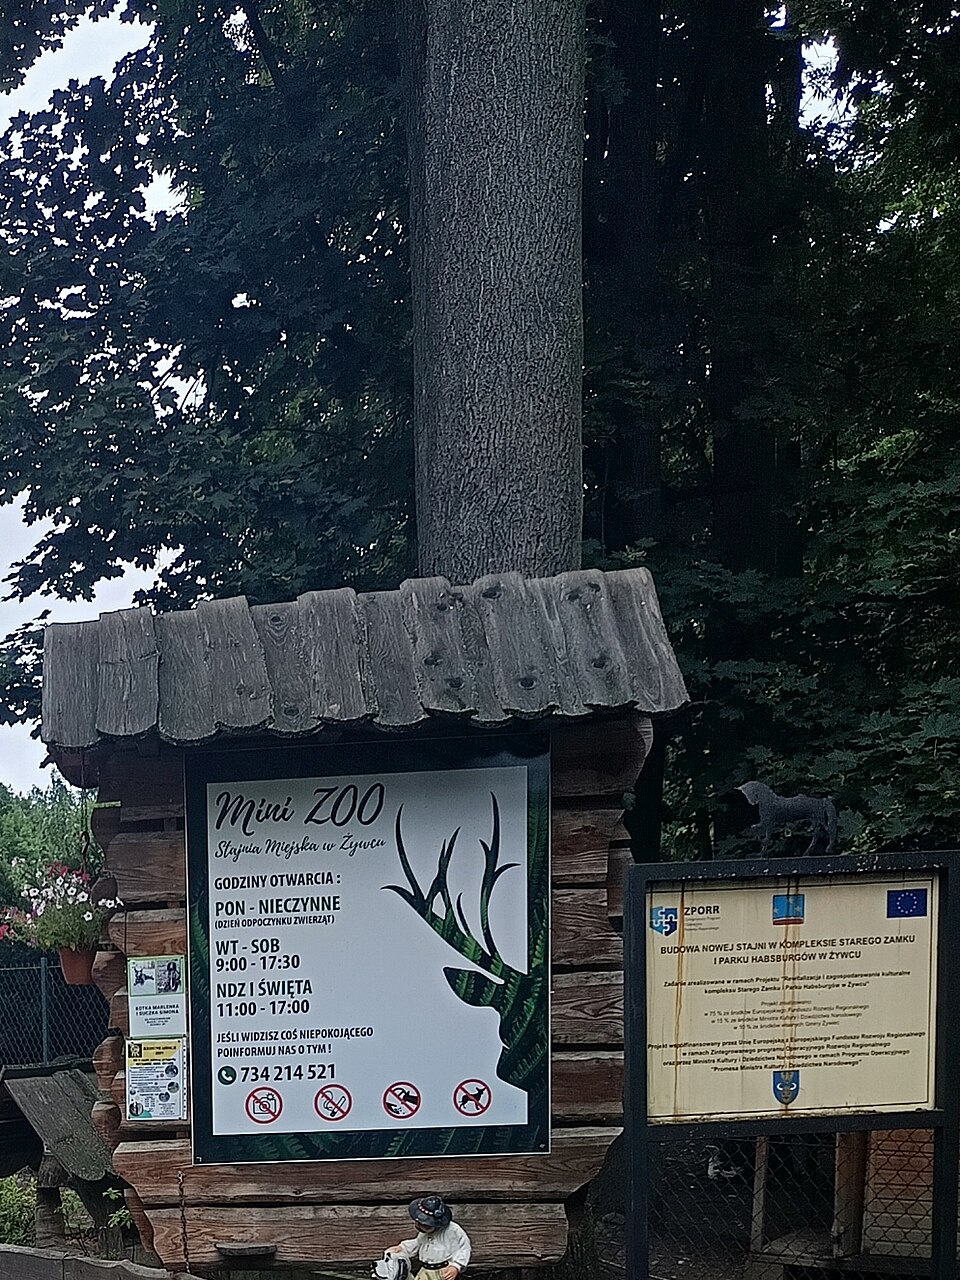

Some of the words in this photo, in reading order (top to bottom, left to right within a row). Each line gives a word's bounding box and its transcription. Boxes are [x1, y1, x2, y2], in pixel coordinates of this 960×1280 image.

[215, 792, 294, 836] Mini
[304, 783, 384, 826] ZOO
[215, 841, 262, 862] Stajnia
[265, 836, 319, 859] Miejska
[323, 843, 336, 851] w
[340, 833, 386, 856] Żywcu
[215, 875, 267, 890] GODZINY
[270, 872, 333, 887] OTWARCIA
[216, 901, 245, 916] PON
[259, 896, 340, 914] NIECZYNNE
[685, 906, 720, 915] ZPORR
[215, 918, 239, 929] (DZIEŃ
[242, 917, 291, 927] ODPOCZYNKU
[294, 915, 335, 925] ZWIERZĄT)
[216, 940, 238, 955] WT
[251, 939, 280, 954] SOB
[661, 945, 700, 954] BUDOWA
[702, 944, 734, 952] NOWEJ
[736, 942, 766, 950] STAJNI
[780, 939, 836, 949] KOMPLEKSIE
[839, 937, 881, 946] STAREGO
[884, 935, 915, 944] ZAMKU
[216, 957, 247, 972] 9:00
[260, 955, 300, 970] 17:30
[719, 956, 749, 964] PARKU
[751, 953, 816, 963] HABSBURGÓW
[829, 951, 861, 960] ŻYWCU
[217, 983, 246, 998] NDZ
[250, 982, 254, 996] I
[258, 979, 312, 998] ŚWIĘTA
[217, 1002, 256, 1017] 11:00
[270, 1000, 310, 1014] 17:00
[217, 1032, 239, 1043] JEŚLI
[241, 1031, 278, 1042] WIDZISZ
[281, 1029, 297, 1040] COŚ
[300, 1027, 373, 1040] NIEPOKOJĄCEGO
[218, 1046, 275, 1058] POINFORMUJ
[278, 1045, 296, 1055] NAS
[299, 1045, 304, 1054] O
[306, 1044, 326, 1054] TYM
[328, 1044, 331, 1053] !
[241, 1067, 270, 1082] 734
[274, 1065, 303, 1080] 214
[308, 1064, 335, 1079] 521
